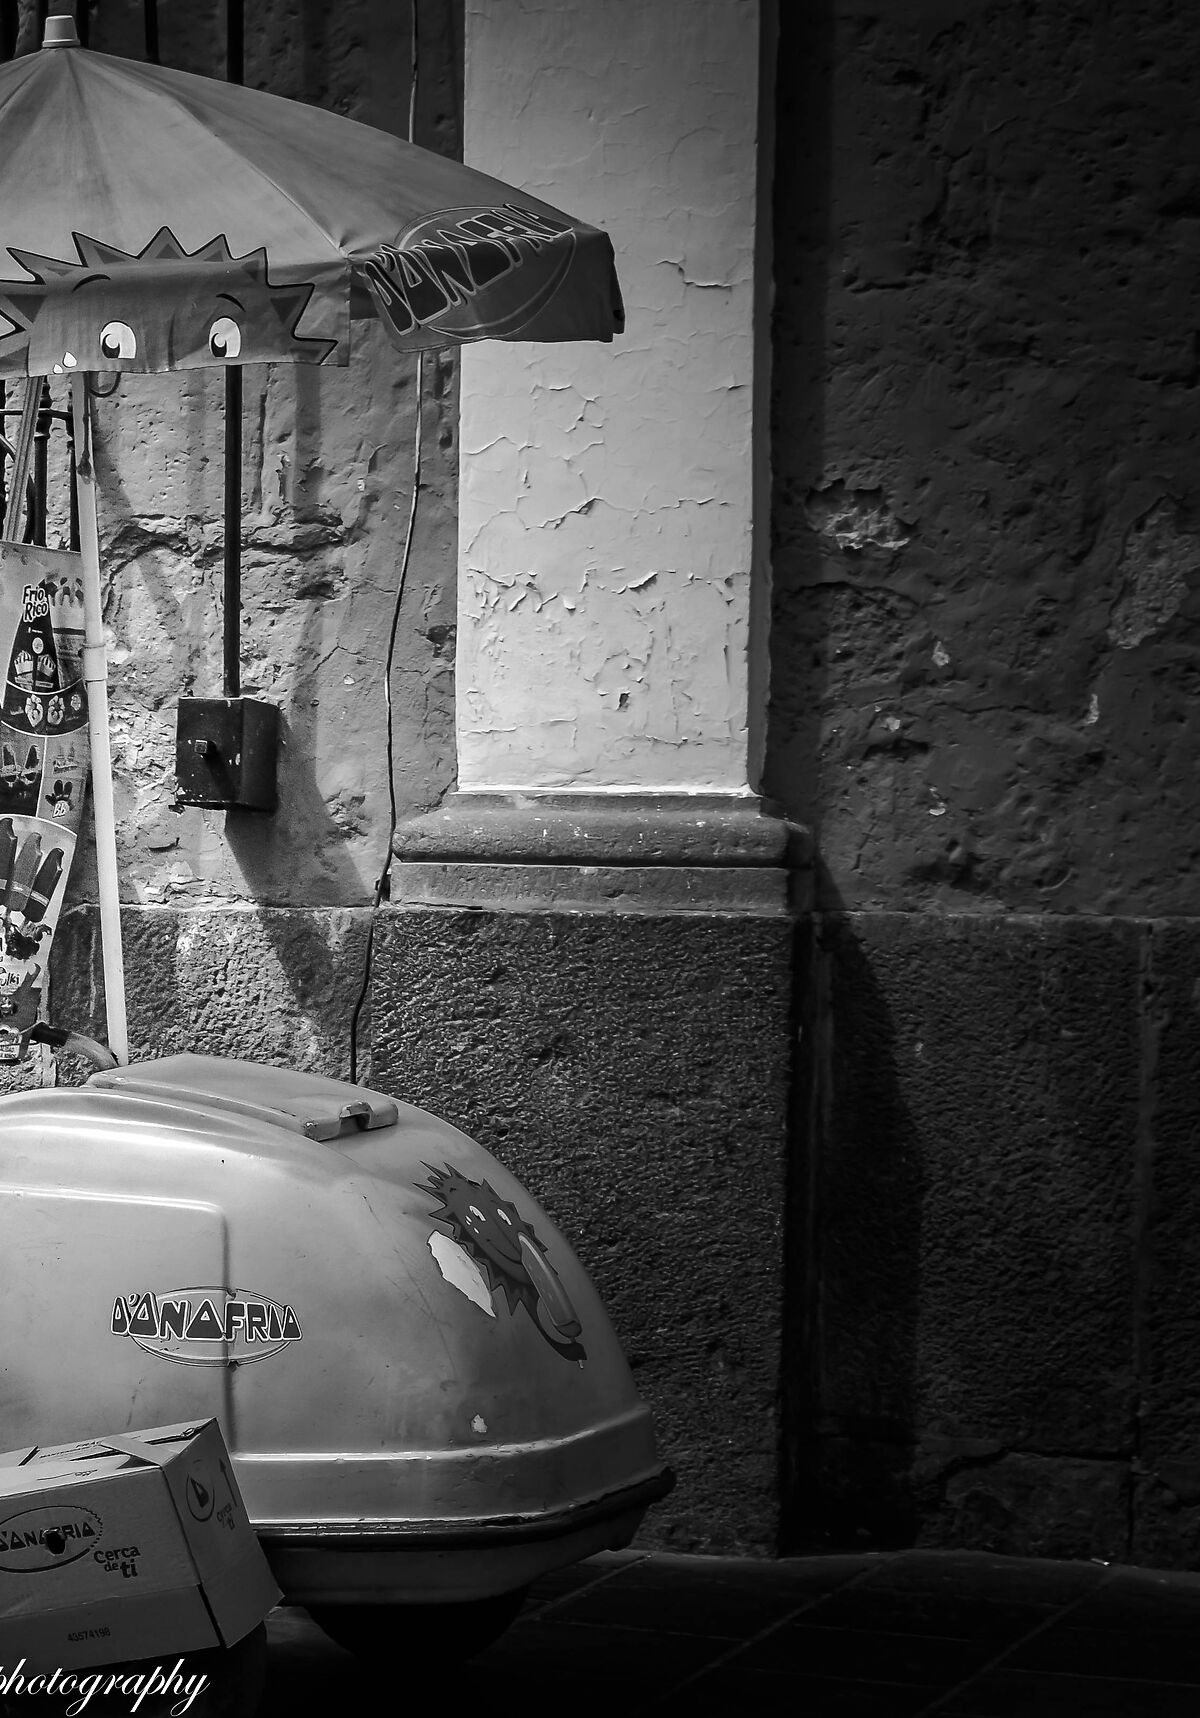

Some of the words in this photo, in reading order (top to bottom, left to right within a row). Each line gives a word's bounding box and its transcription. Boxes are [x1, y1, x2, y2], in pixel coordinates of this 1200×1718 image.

[23, 585, 45, 604] Frio
[24, 602, 48, 621] Rico
[93, 1545, 141, 1564] Cerca
[104, 1561, 120, 1573] de
[119, 1559, 139, 1579] ti
